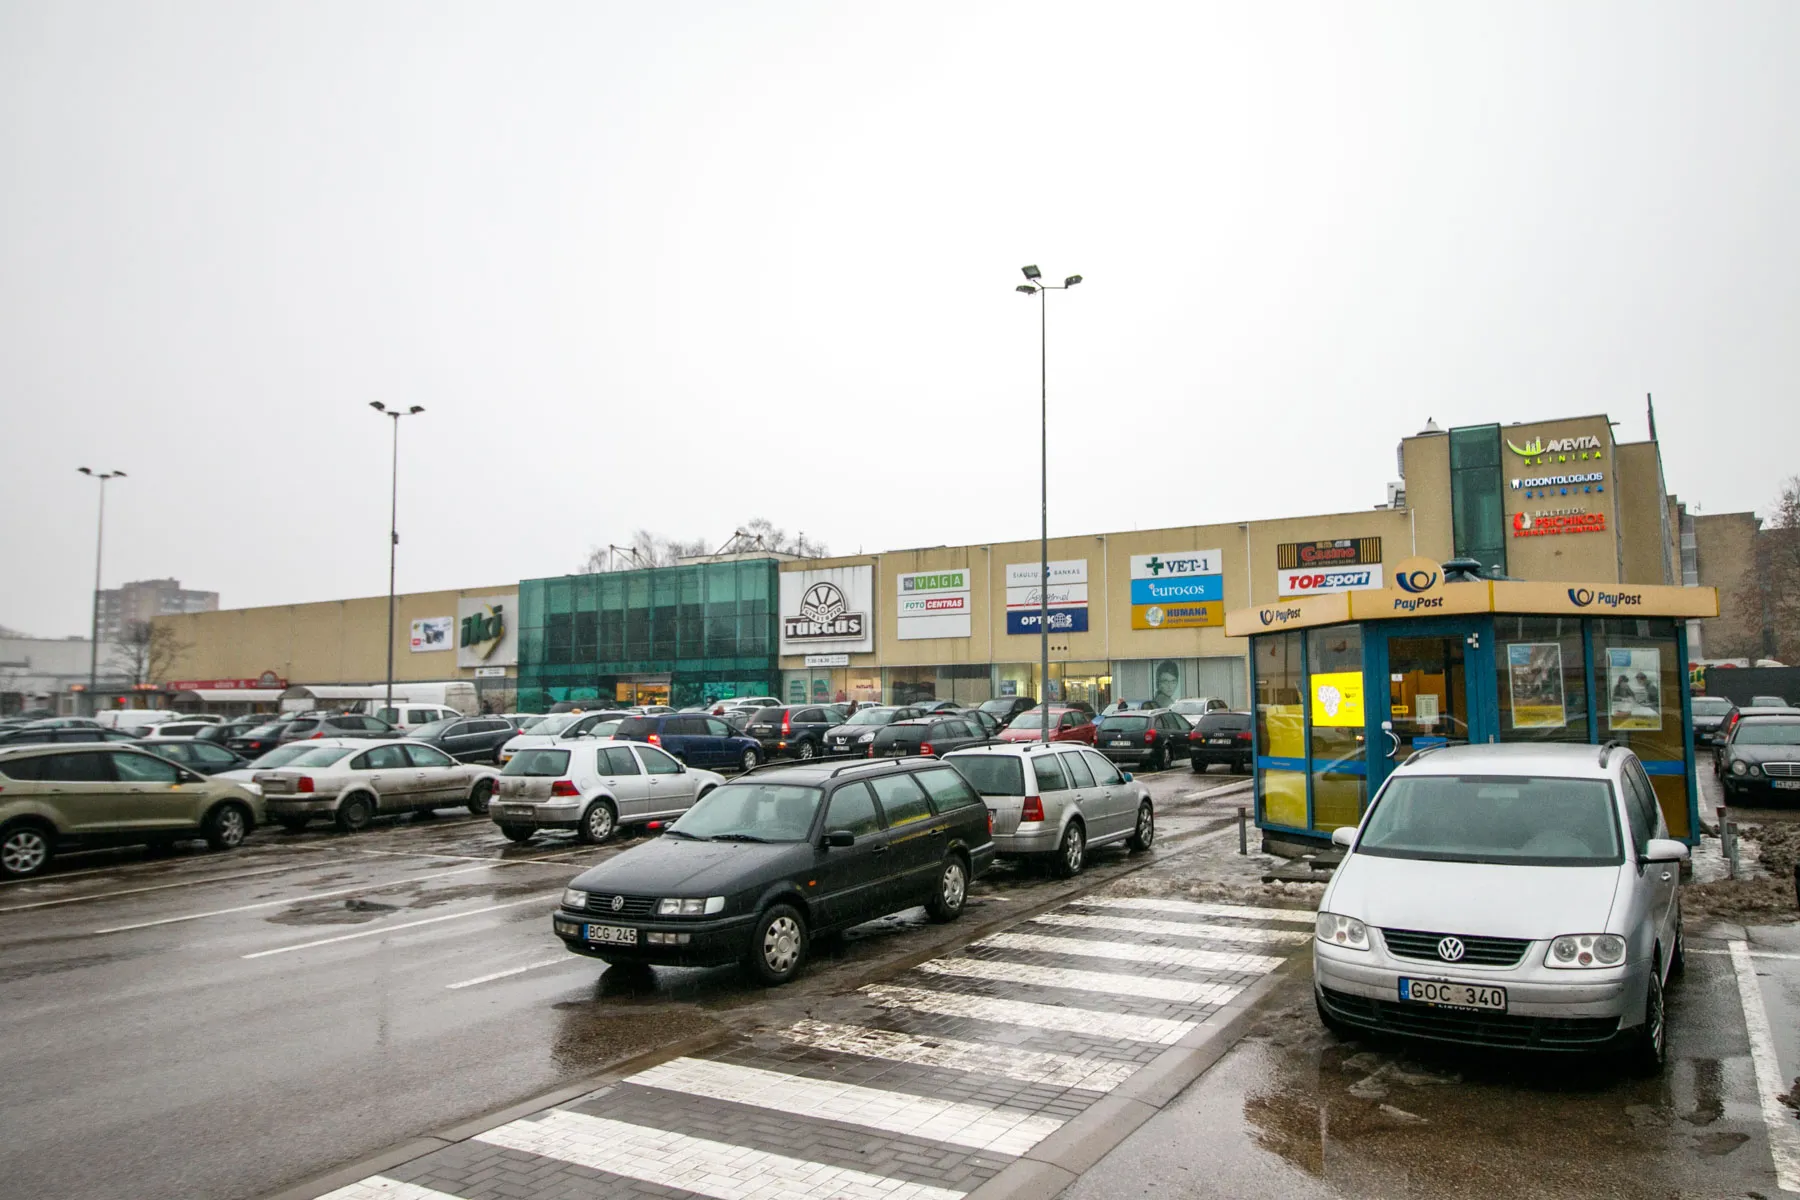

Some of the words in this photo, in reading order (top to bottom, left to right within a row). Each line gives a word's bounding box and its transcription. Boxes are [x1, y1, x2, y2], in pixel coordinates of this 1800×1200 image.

[1546, 436, 1601, 453] AVEVITA
[1524, 450, 1602, 466] KLINIKA
[1524, 472, 1604, 488] ODONTOLOGIJOS
[1535, 507, 1586, 517] BALTIJOS
[1534, 513, 1605, 529] PSICHIKOS
[1301, 546, 1356, 562] Casino
[1053, 568, 1080, 576] BANKAS
[1165, 558, 1209, 573] VET-1
[917, 575, 961, 587] VAGA
[1394, 597, 1443, 611] PayPost
[1597, 591, 1642, 607] PayPost
[1021, 613, 1073, 626] OPTKOS
[1275, 608, 1301, 624] PayPost
[785, 619, 861, 636] TURGUS
[588, 925, 610, 940] BCG
[1411, 981, 1451, 1003] GOC
[1465, 987, 1503, 1008] 340
